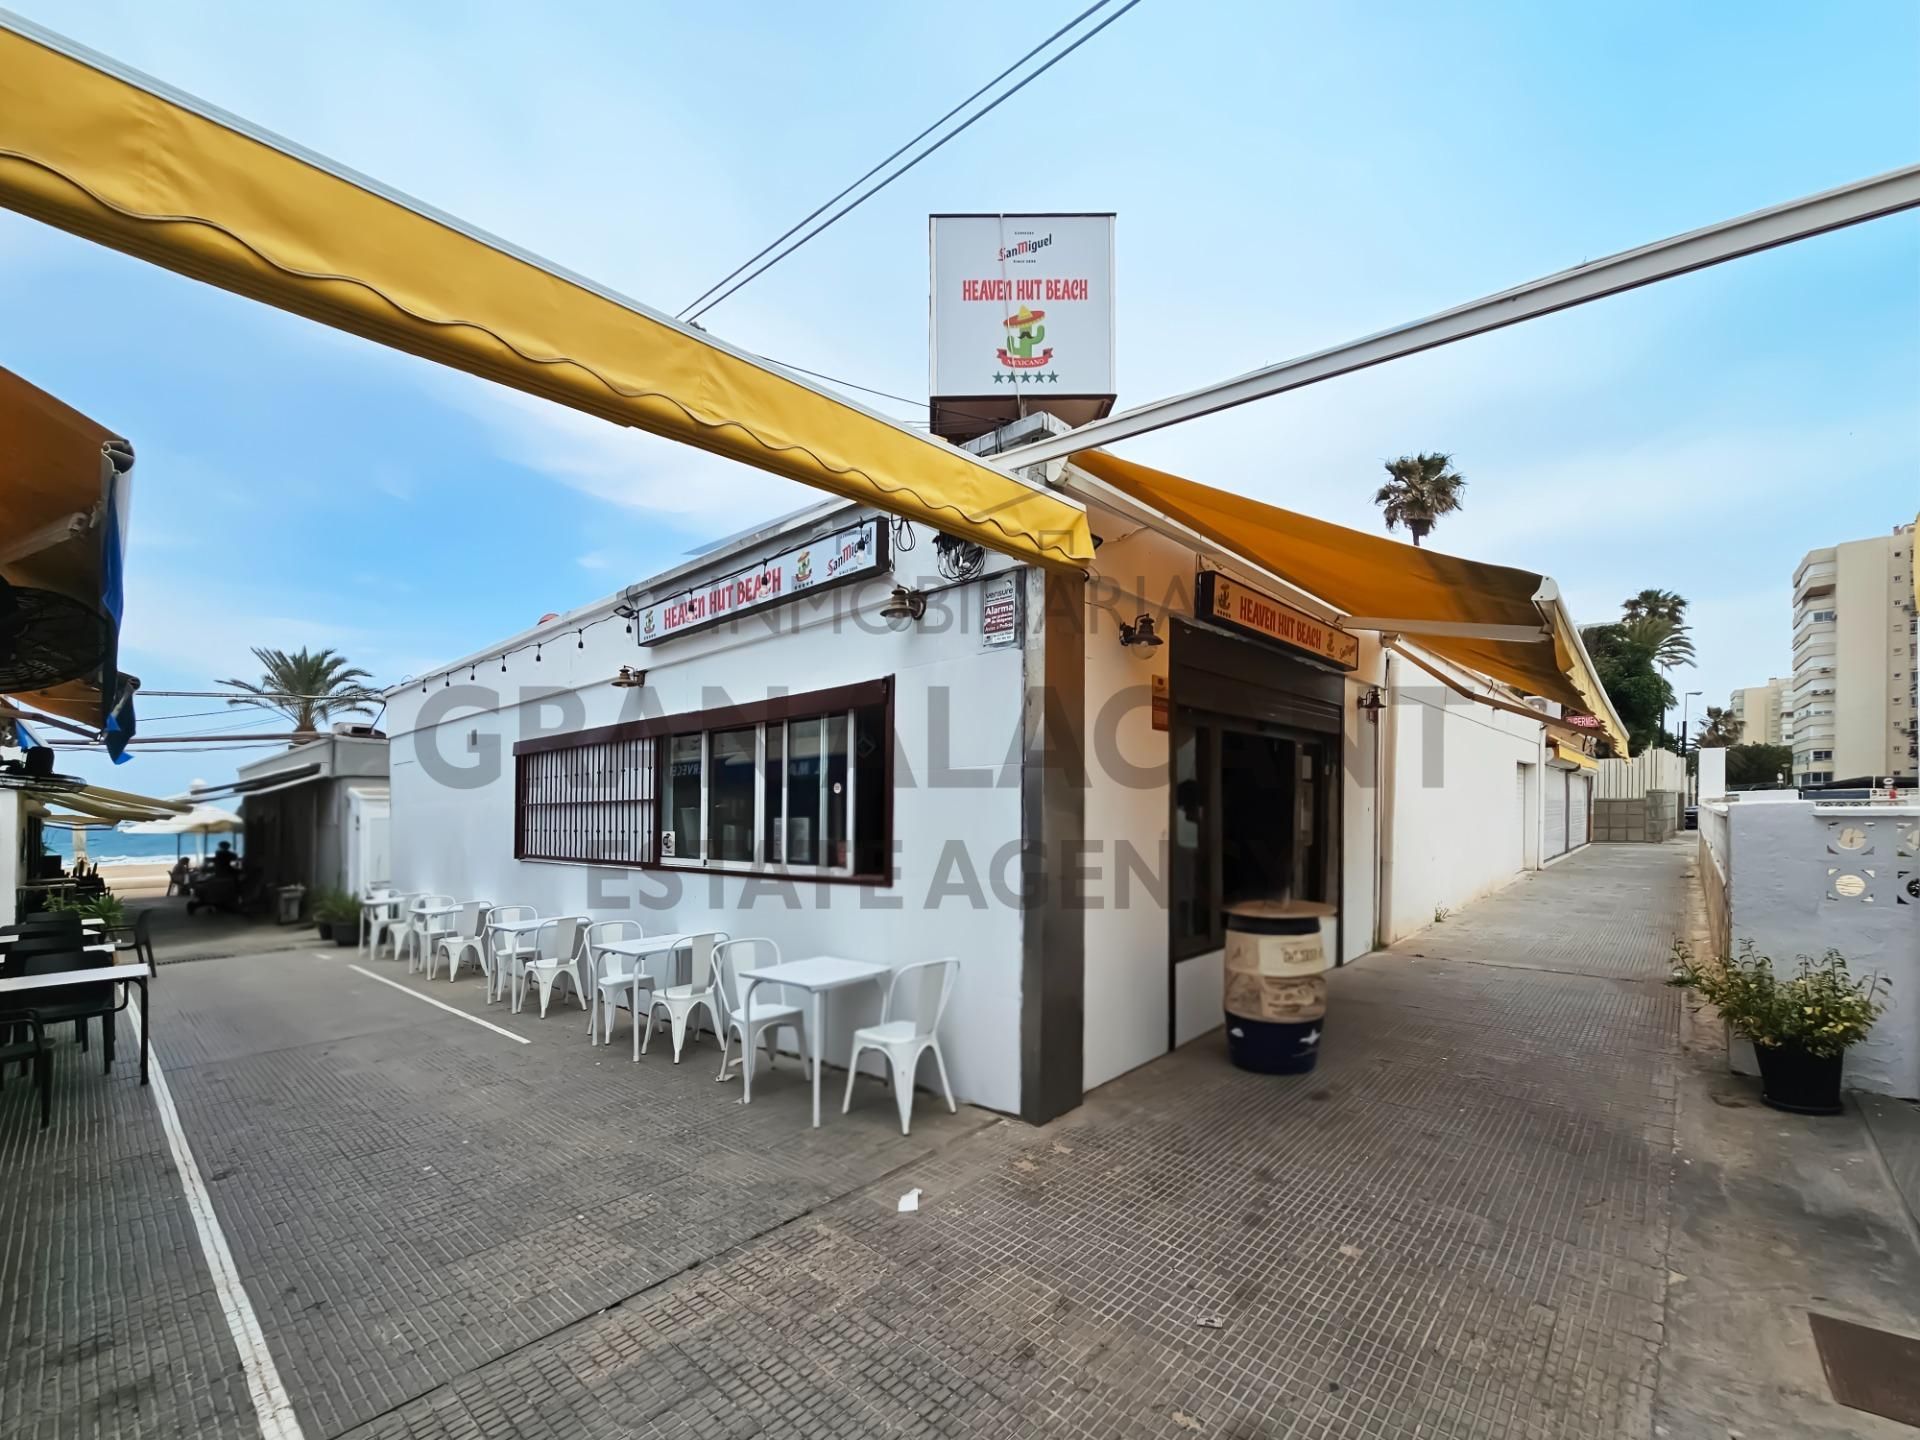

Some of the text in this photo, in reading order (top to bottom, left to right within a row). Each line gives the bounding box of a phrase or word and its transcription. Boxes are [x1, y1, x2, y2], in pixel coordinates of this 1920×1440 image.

[1017, 279, 1043, 300] HUT
[1045, 279, 1088, 300] BEACH
[709, 587, 734, 615] HUT
[985, 604, 1014, 615] Alarma
[1278, 613, 1295, 640] HUT
[1296, 623, 1322, 650] BEACH
